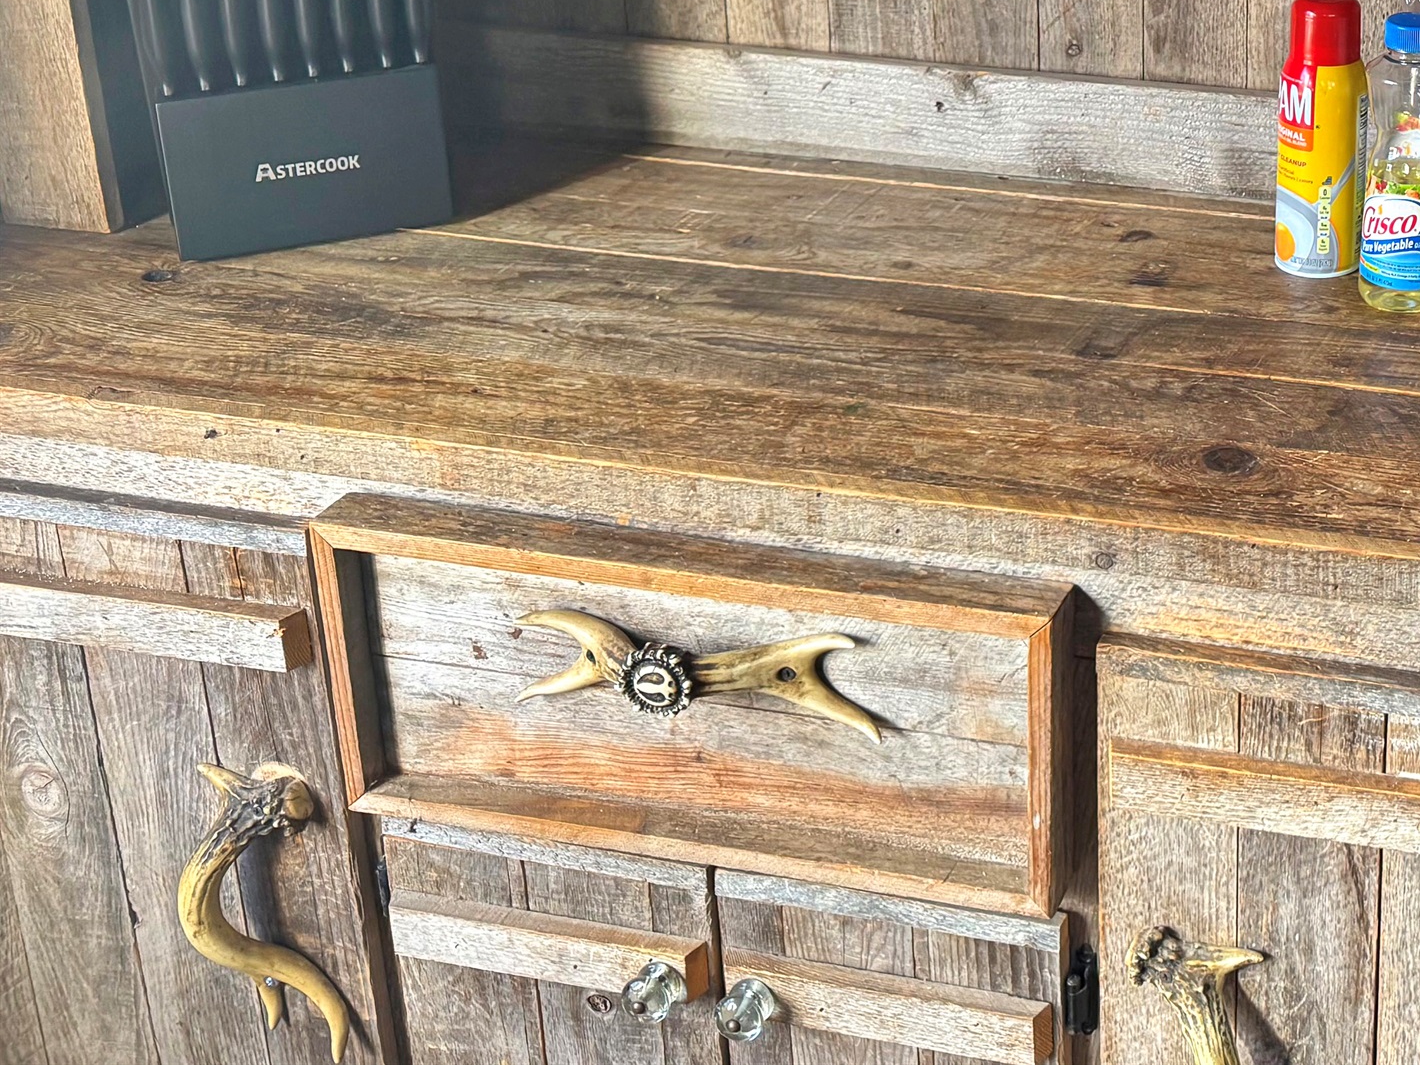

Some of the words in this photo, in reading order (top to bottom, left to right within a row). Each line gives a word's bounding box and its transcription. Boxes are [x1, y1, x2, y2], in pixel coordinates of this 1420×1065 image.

[1279, 74, 1312, 126] AM
[255, 154, 361, 183] ASTERCOOK
[1280, 154, 1307, 167] CLEANUP
[1362, 204, 1418, 239] Crisco
[1362, 240, 1374, 252] Pure
[1374, 238, 1414, 254] Vegetable
